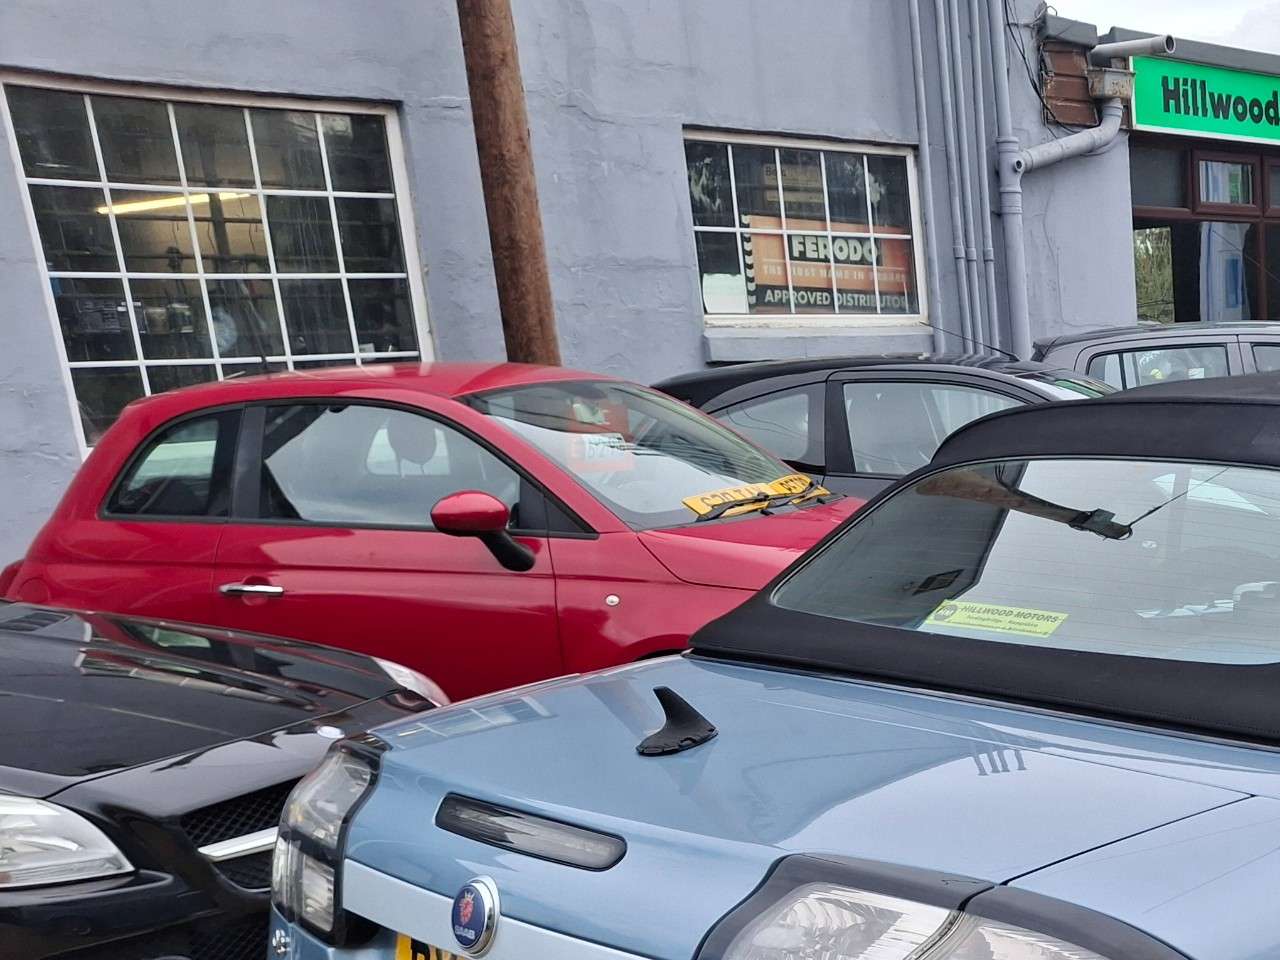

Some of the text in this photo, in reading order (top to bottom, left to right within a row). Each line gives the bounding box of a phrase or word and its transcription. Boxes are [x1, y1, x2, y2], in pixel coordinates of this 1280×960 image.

[792, 235, 877, 261] FERODO
[764, 289, 830, 305] APPROVED
[960, 605, 1014, 616] HILLWOOD
[1014, 612, 1060, 623] MOTORS
